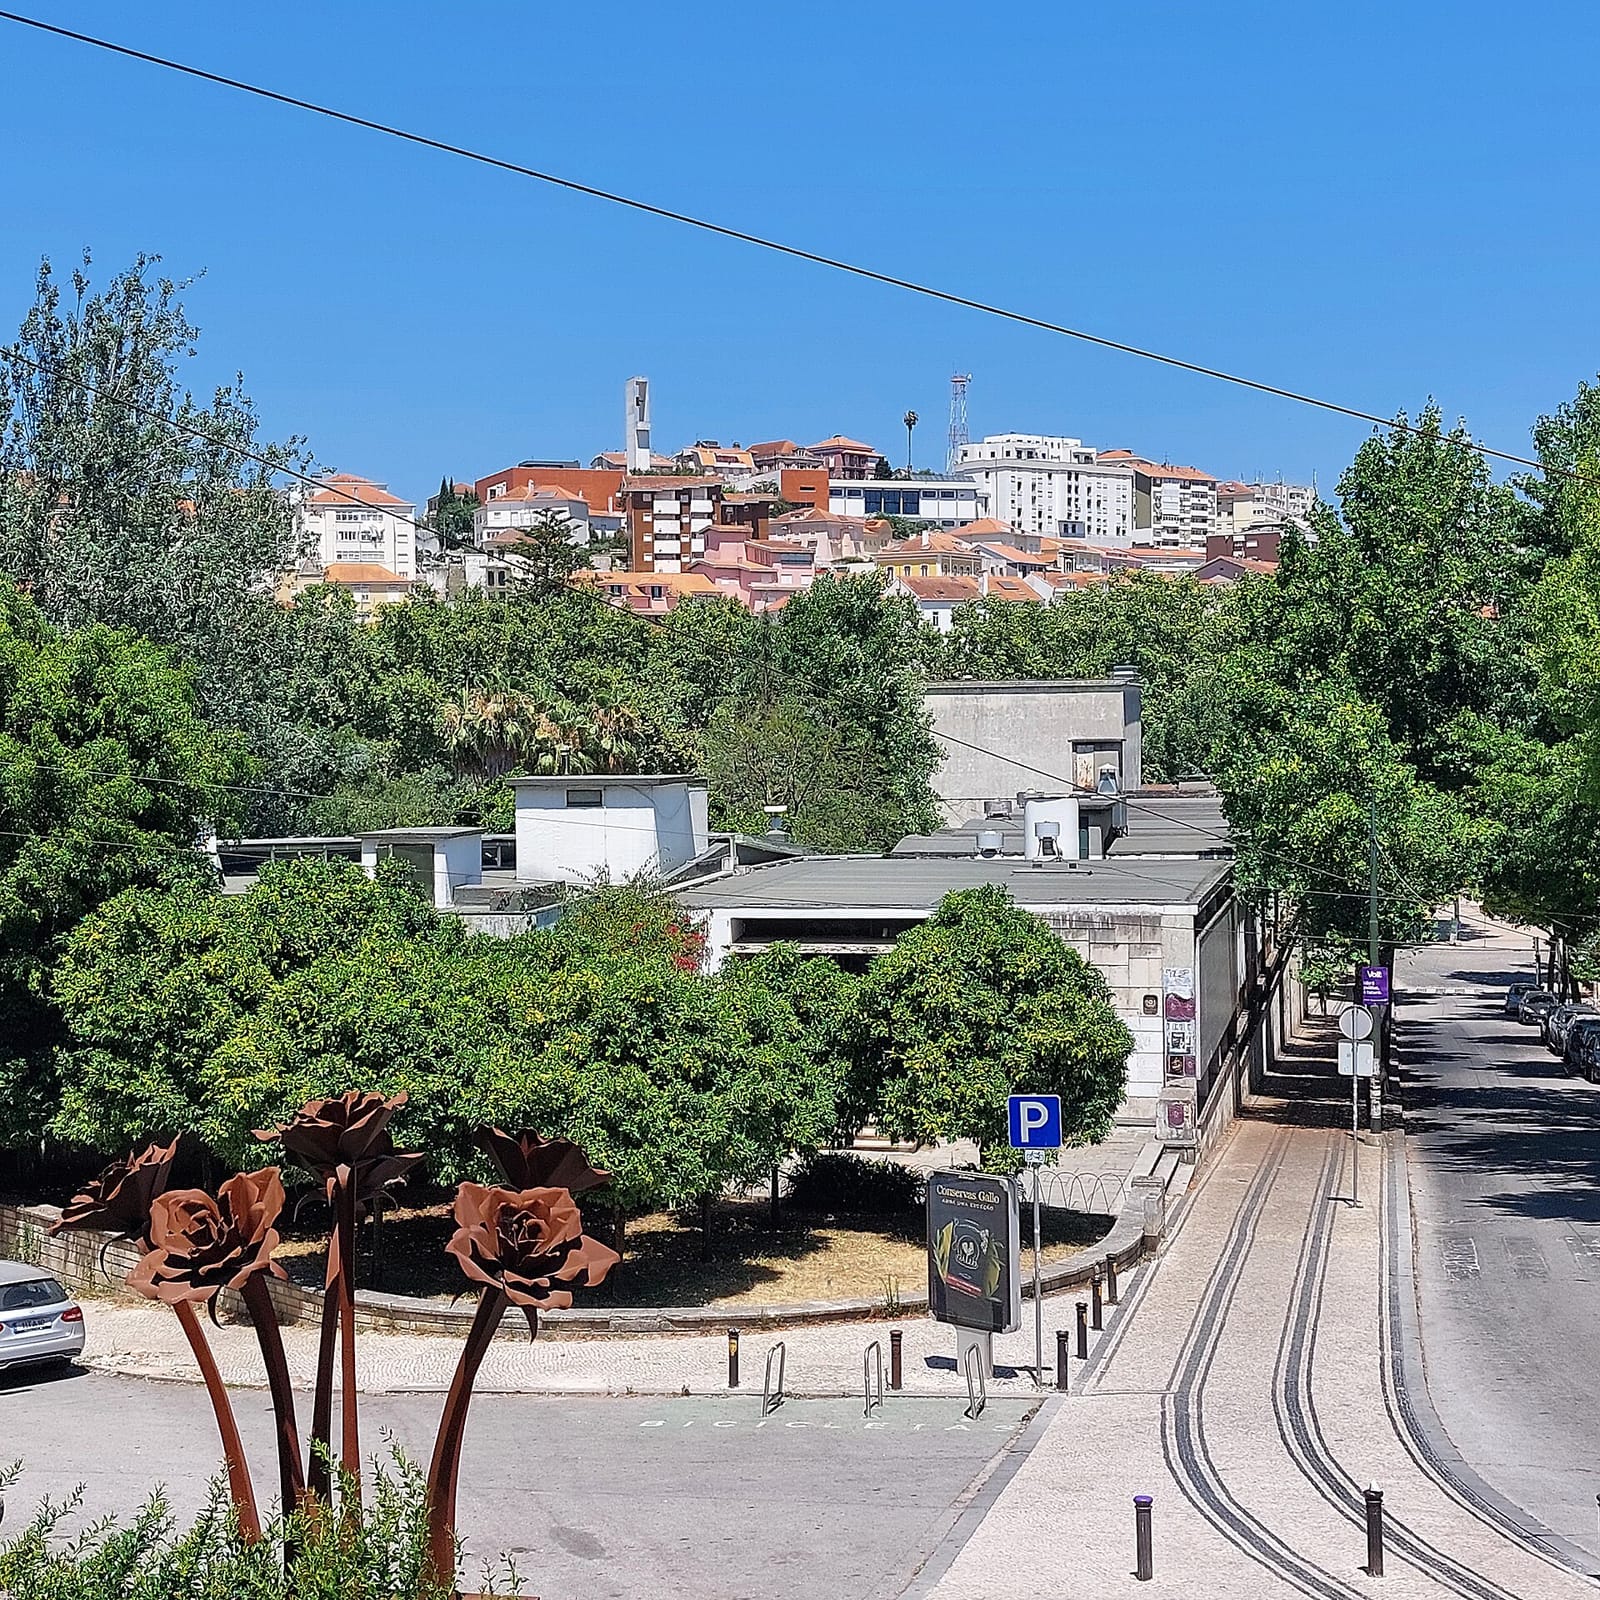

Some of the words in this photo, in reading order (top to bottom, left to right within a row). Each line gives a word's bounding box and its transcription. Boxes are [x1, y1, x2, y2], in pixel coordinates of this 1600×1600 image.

[1367, 969, 1383, 979] Volt
[1019, 1101, 1049, 1143] P
[936, 1184, 977, 1200] Conservas
[978, 1191, 1000, 1204] Gallo
